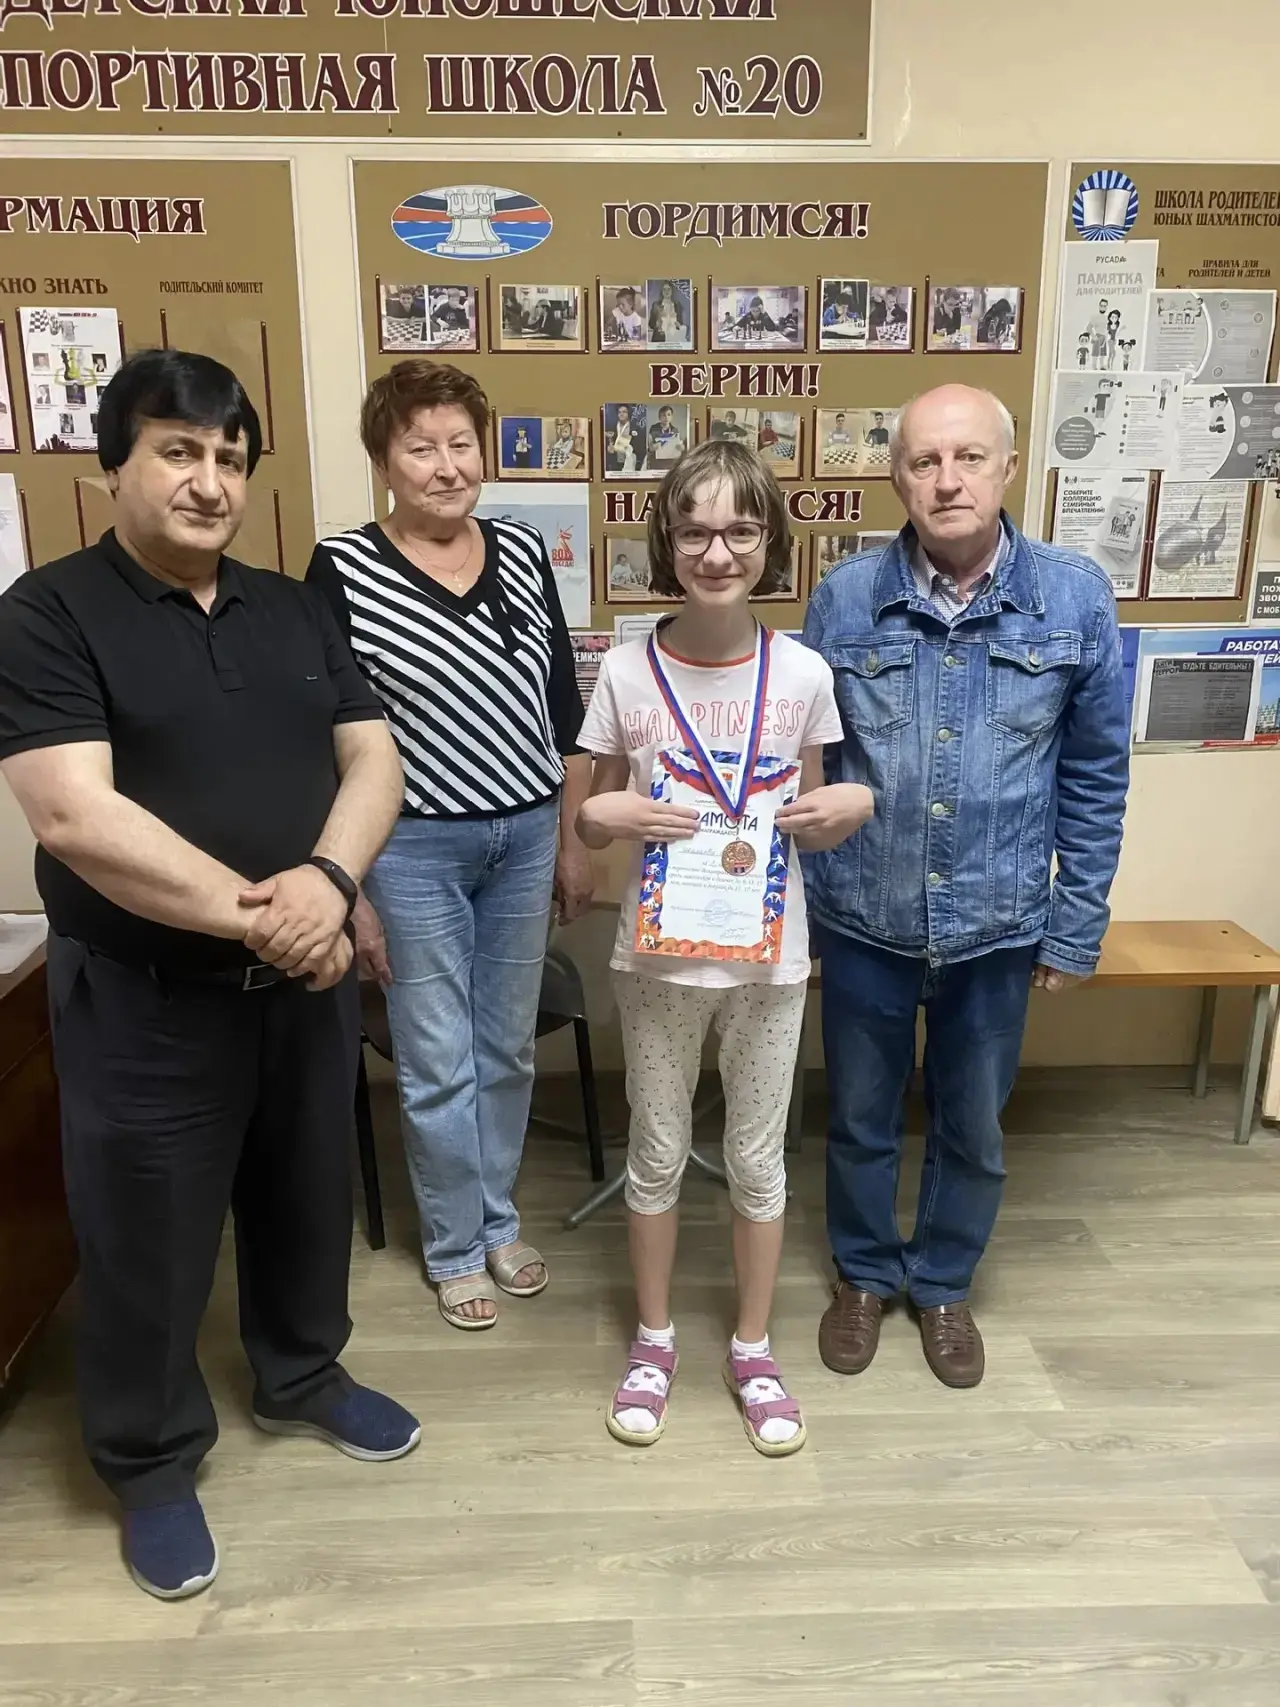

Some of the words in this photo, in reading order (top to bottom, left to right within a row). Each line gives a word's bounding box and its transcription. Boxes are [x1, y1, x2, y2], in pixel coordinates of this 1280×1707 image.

[0, 47, 400, 114] ПОРТИВНАЯ
[424, 53, 668, 115] ШКОЛА
[693, 54, 823, 119] №20
[1154, 190, 1204, 209] ШКОЛА
[0, 196, 207, 243] РМАЦИЯ
[602, 200, 871, 247] ГОРДИМСЯ!
[1153, 213, 1193, 226] ЮНЫХ
[1202, 260, 1240, 268] ПРАВИЛА
[1241, 260, 1259, 268] ДЛЯ
[1077, 272, 1143, 285] ПАМЯТКА
[1188, 269, 1235, 277] РОДИТЕЛЕЙ
[1236, 269, 1243, 277] И
[1244, 269, 1271, 277] ДЕТЕЙ
[43, 277, 108, 295] ЗНАТЬ
[160, 280, 224, 294] РОДИТЕЛЬСКИЙ
[226, 281, 263, 294] КОМИТЕТ
[1076, 287, 1093, 296] ДЛЯ
[1094, 286, 1142, 296] РОДИТЕЛЕЙ
[649, 362, 821, 398] ВЕРИМ!
[1259, 594, 1280, 602] ЗВО
[1226, 640, 1280, 652] РАБОТА
[1182, 662, 1206, 670] БУДЬТЕ
